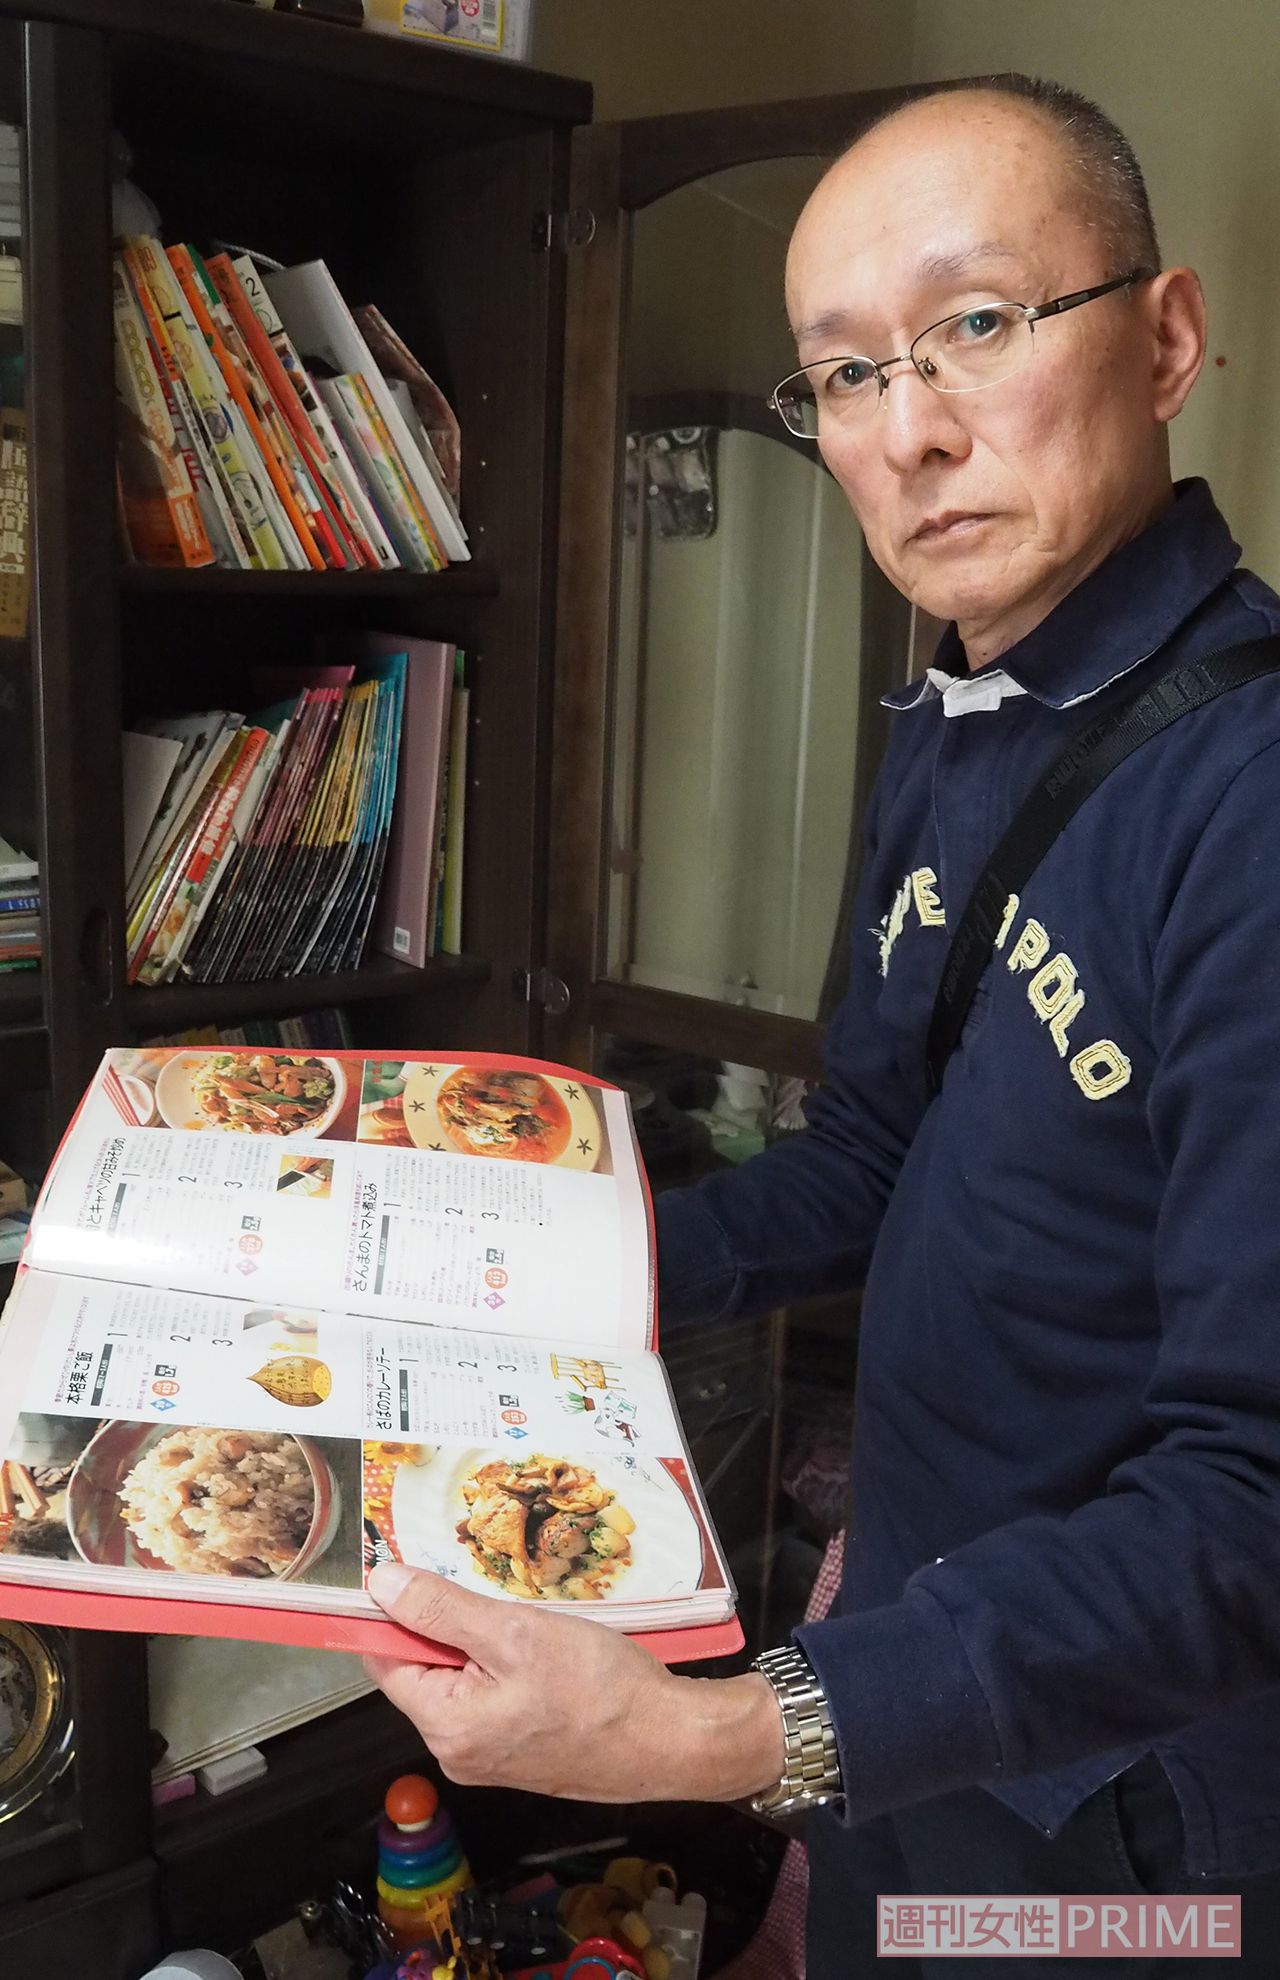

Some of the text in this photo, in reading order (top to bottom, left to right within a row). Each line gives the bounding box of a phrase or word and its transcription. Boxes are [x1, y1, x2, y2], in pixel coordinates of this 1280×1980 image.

[245, 277, 260, 297] 2
[177, 1175, 197, 1184] 2
[224, 1180, 243, 1189] 3
[445, 1207, 463, 1216] 2
[481, 1212, 500, 1221] 3
[352, 1183, 378, 1292] さんまのトマト煮込み
[170, 1334, 191, 1343] 2
[212, 1339, 233, 1347] 3
[458, 1360, 478, 1369] 2
[497, 1364, 517, 1373] 3
[66, 1351, 94, 1405] 本格栗ご飯
[376, 1347, 392, 1430] さばのカレーソテー
